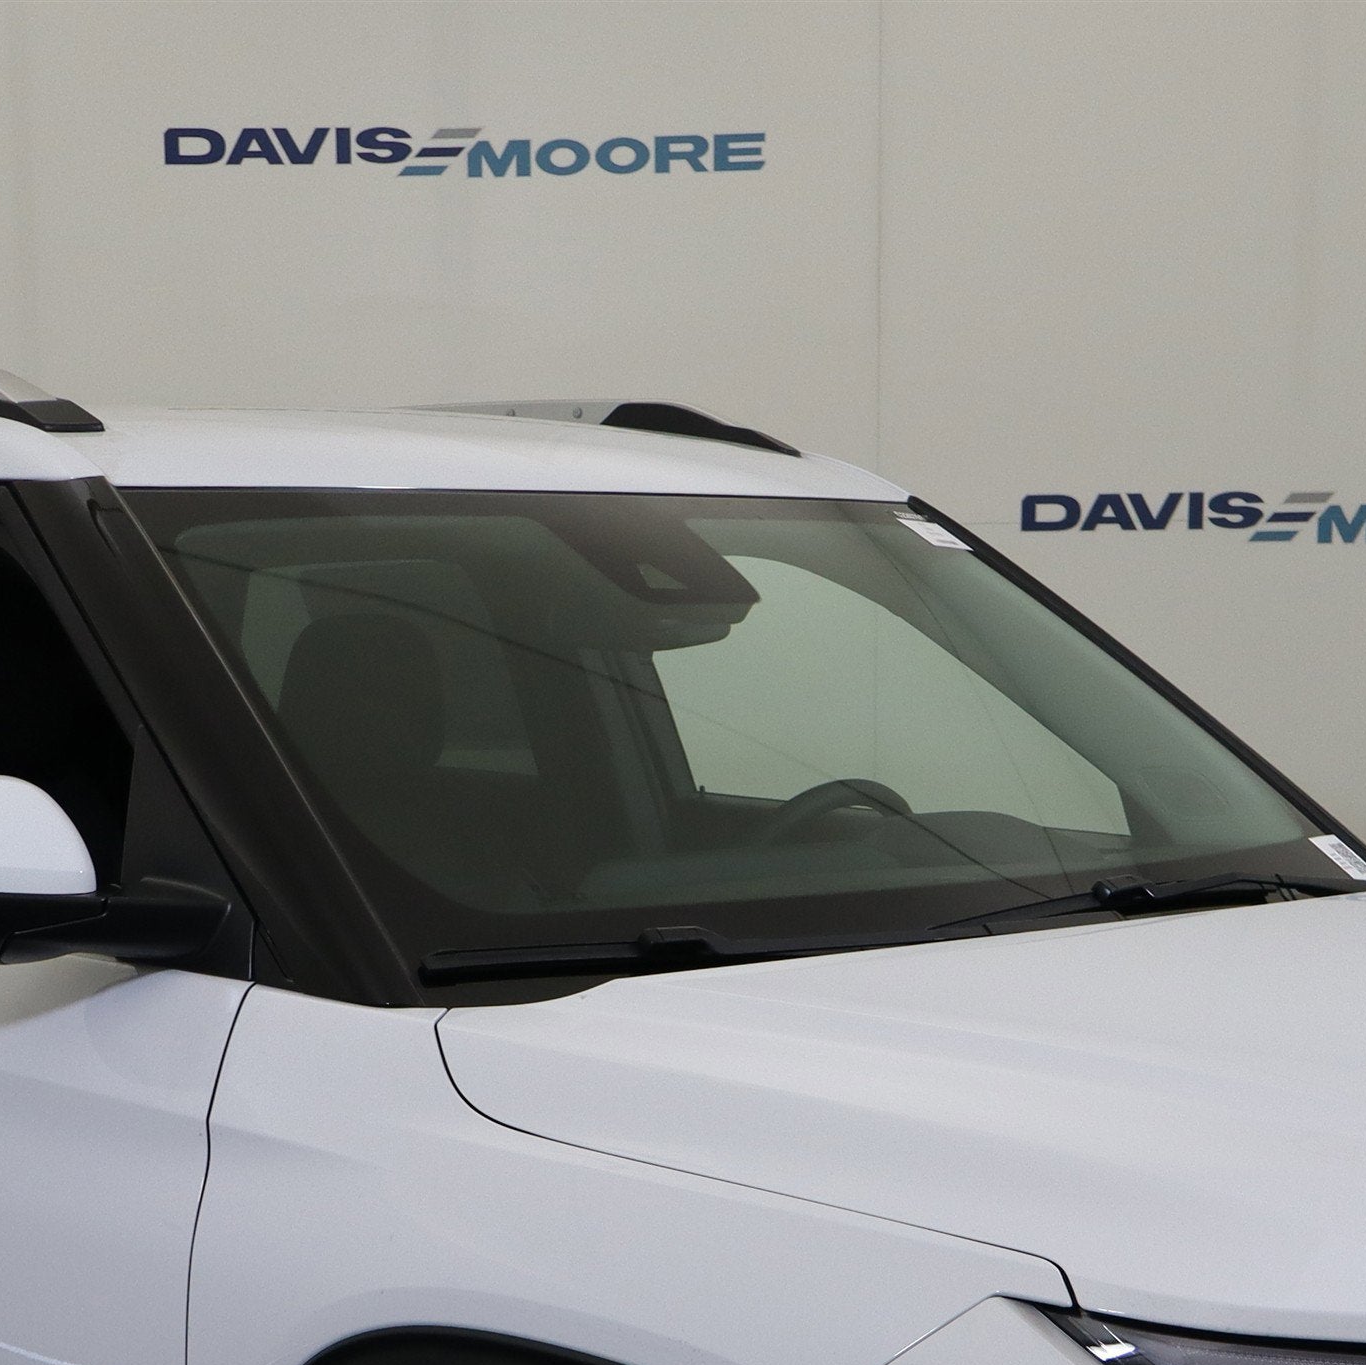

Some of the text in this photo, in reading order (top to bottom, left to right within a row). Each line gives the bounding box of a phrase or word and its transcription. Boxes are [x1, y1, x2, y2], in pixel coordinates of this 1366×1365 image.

[163, 126, 766, 178] DAVIS MOORE
[1020, 491, 1264, 532] DAVIS
